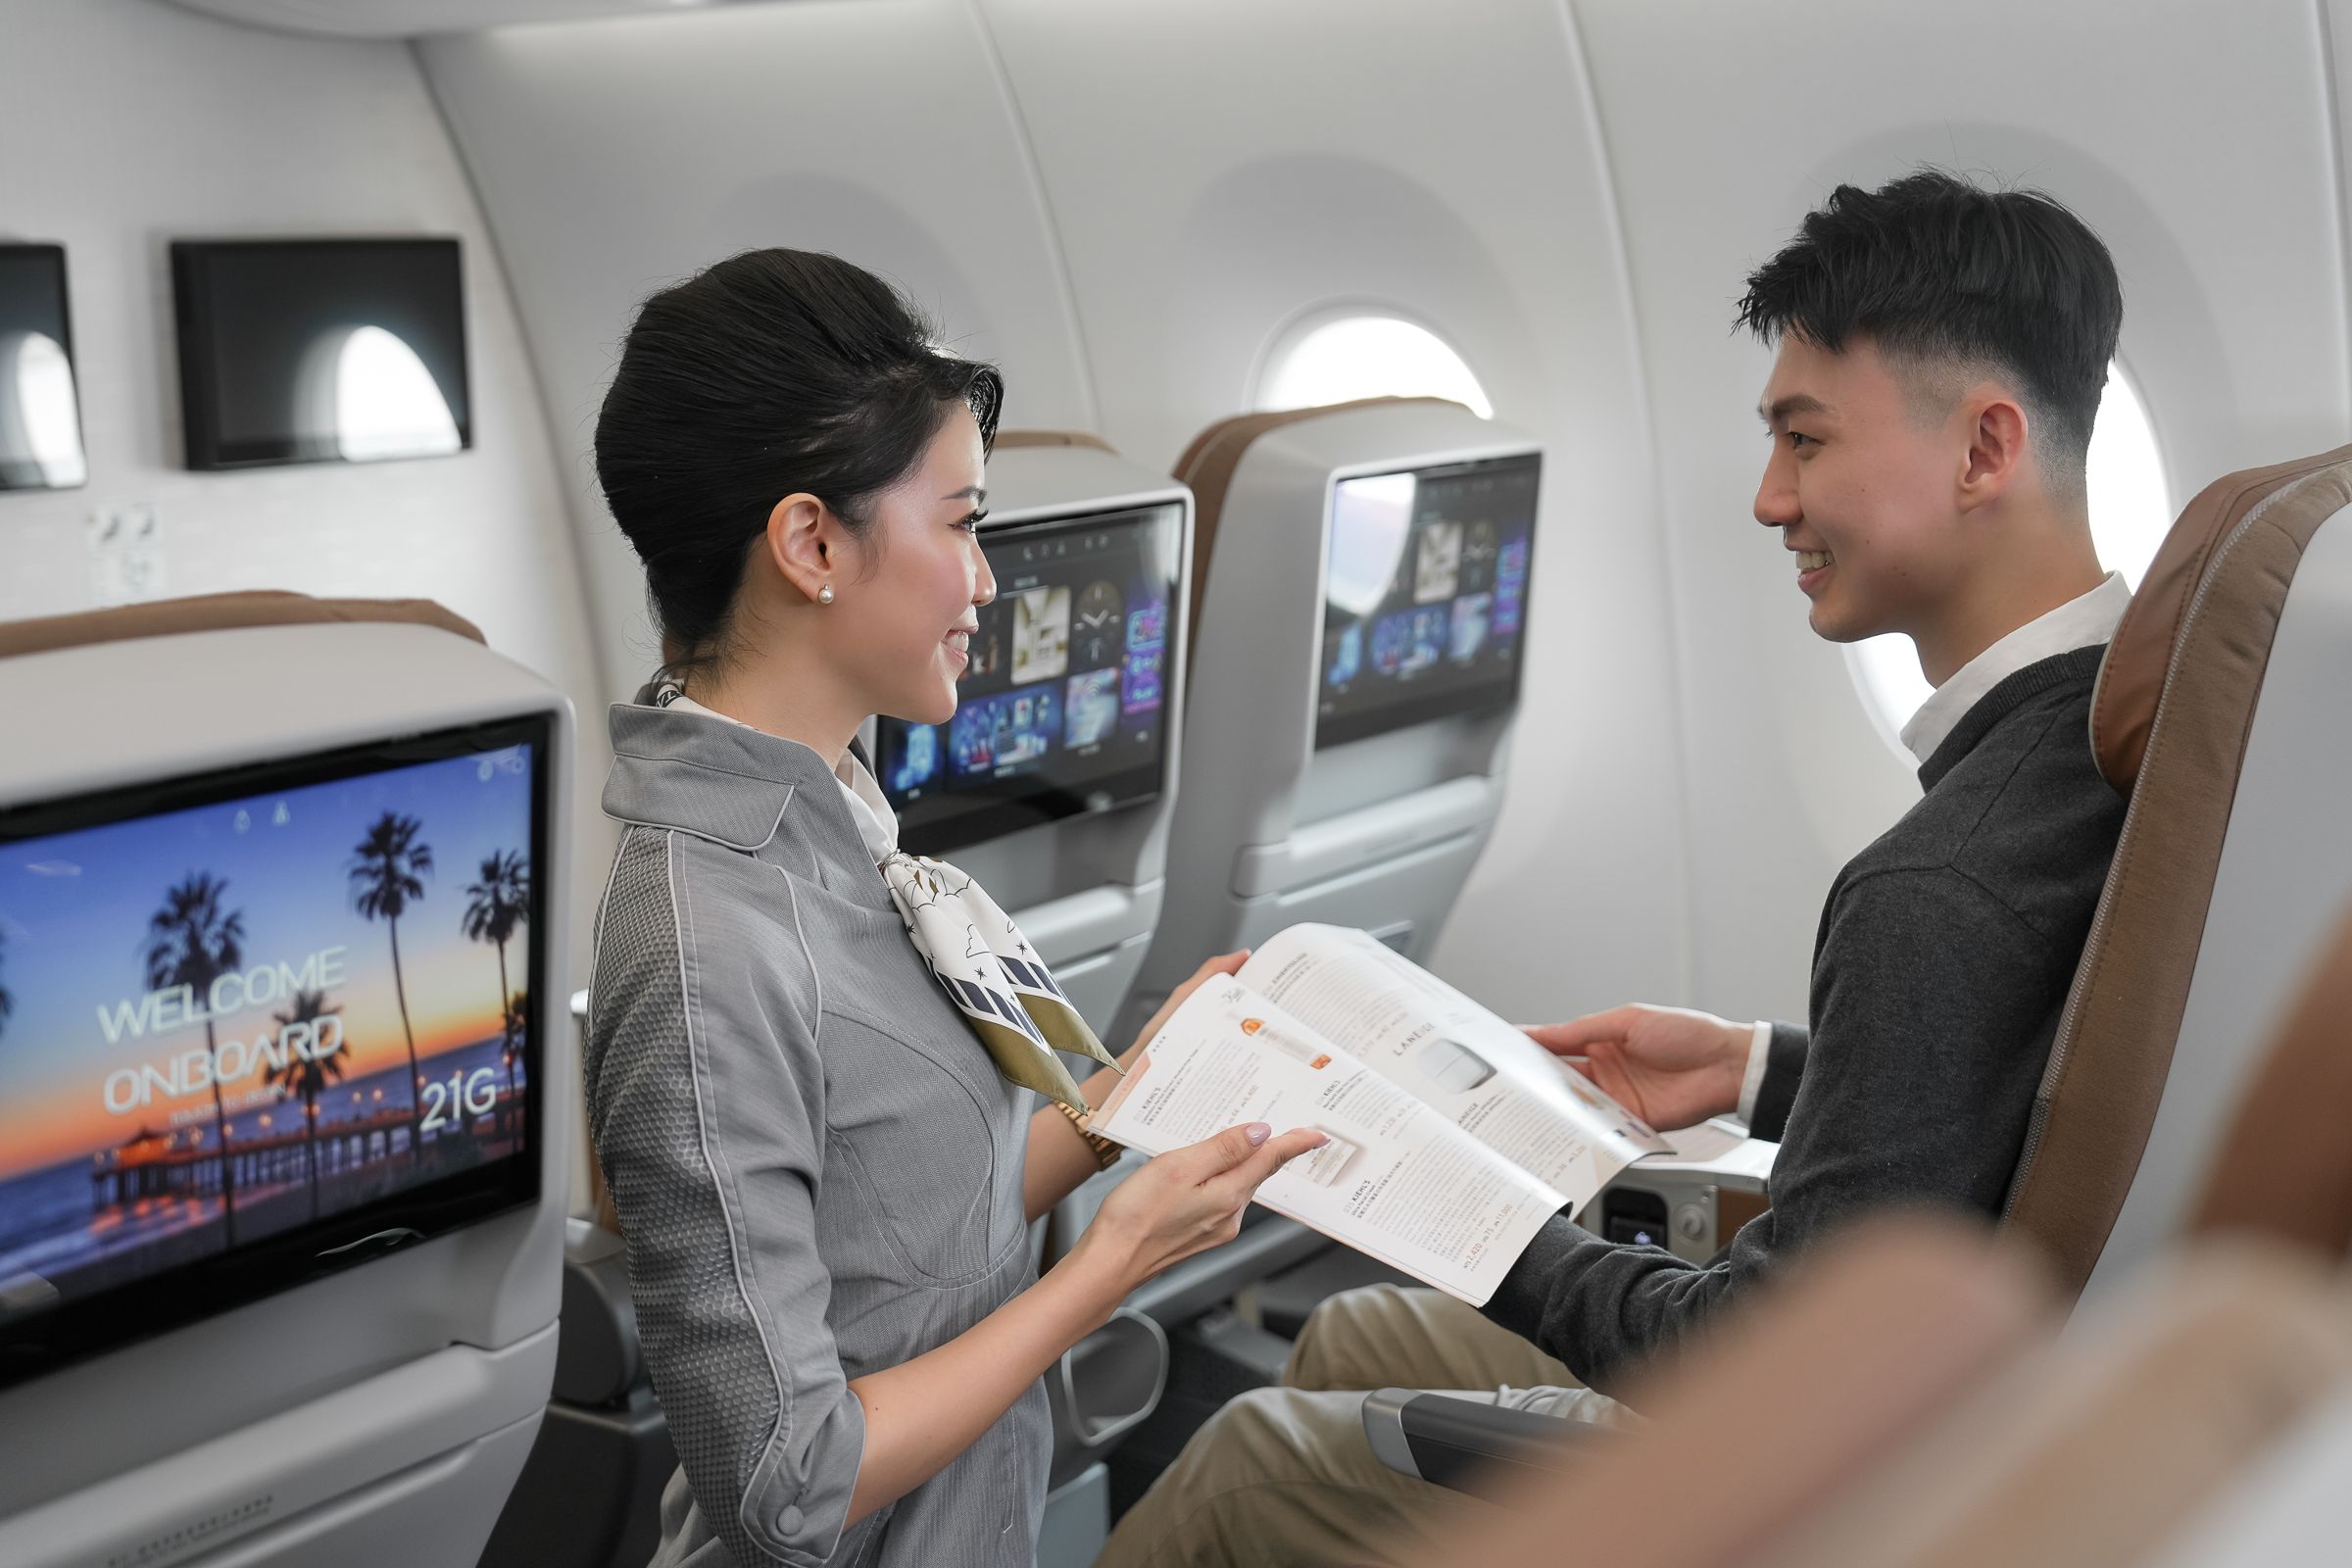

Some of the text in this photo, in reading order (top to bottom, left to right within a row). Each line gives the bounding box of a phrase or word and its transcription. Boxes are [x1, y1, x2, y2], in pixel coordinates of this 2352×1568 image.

[96, 945, 347, 1046] WELCOME
[104, 1014, 343, 1115] ONBOARD
[1142, 1086, 1160, 1108] KIEHL'S
[419, 1066, 497, 1133] 21G
[1351, 1179, 1371, 1201] KIEHL'S
